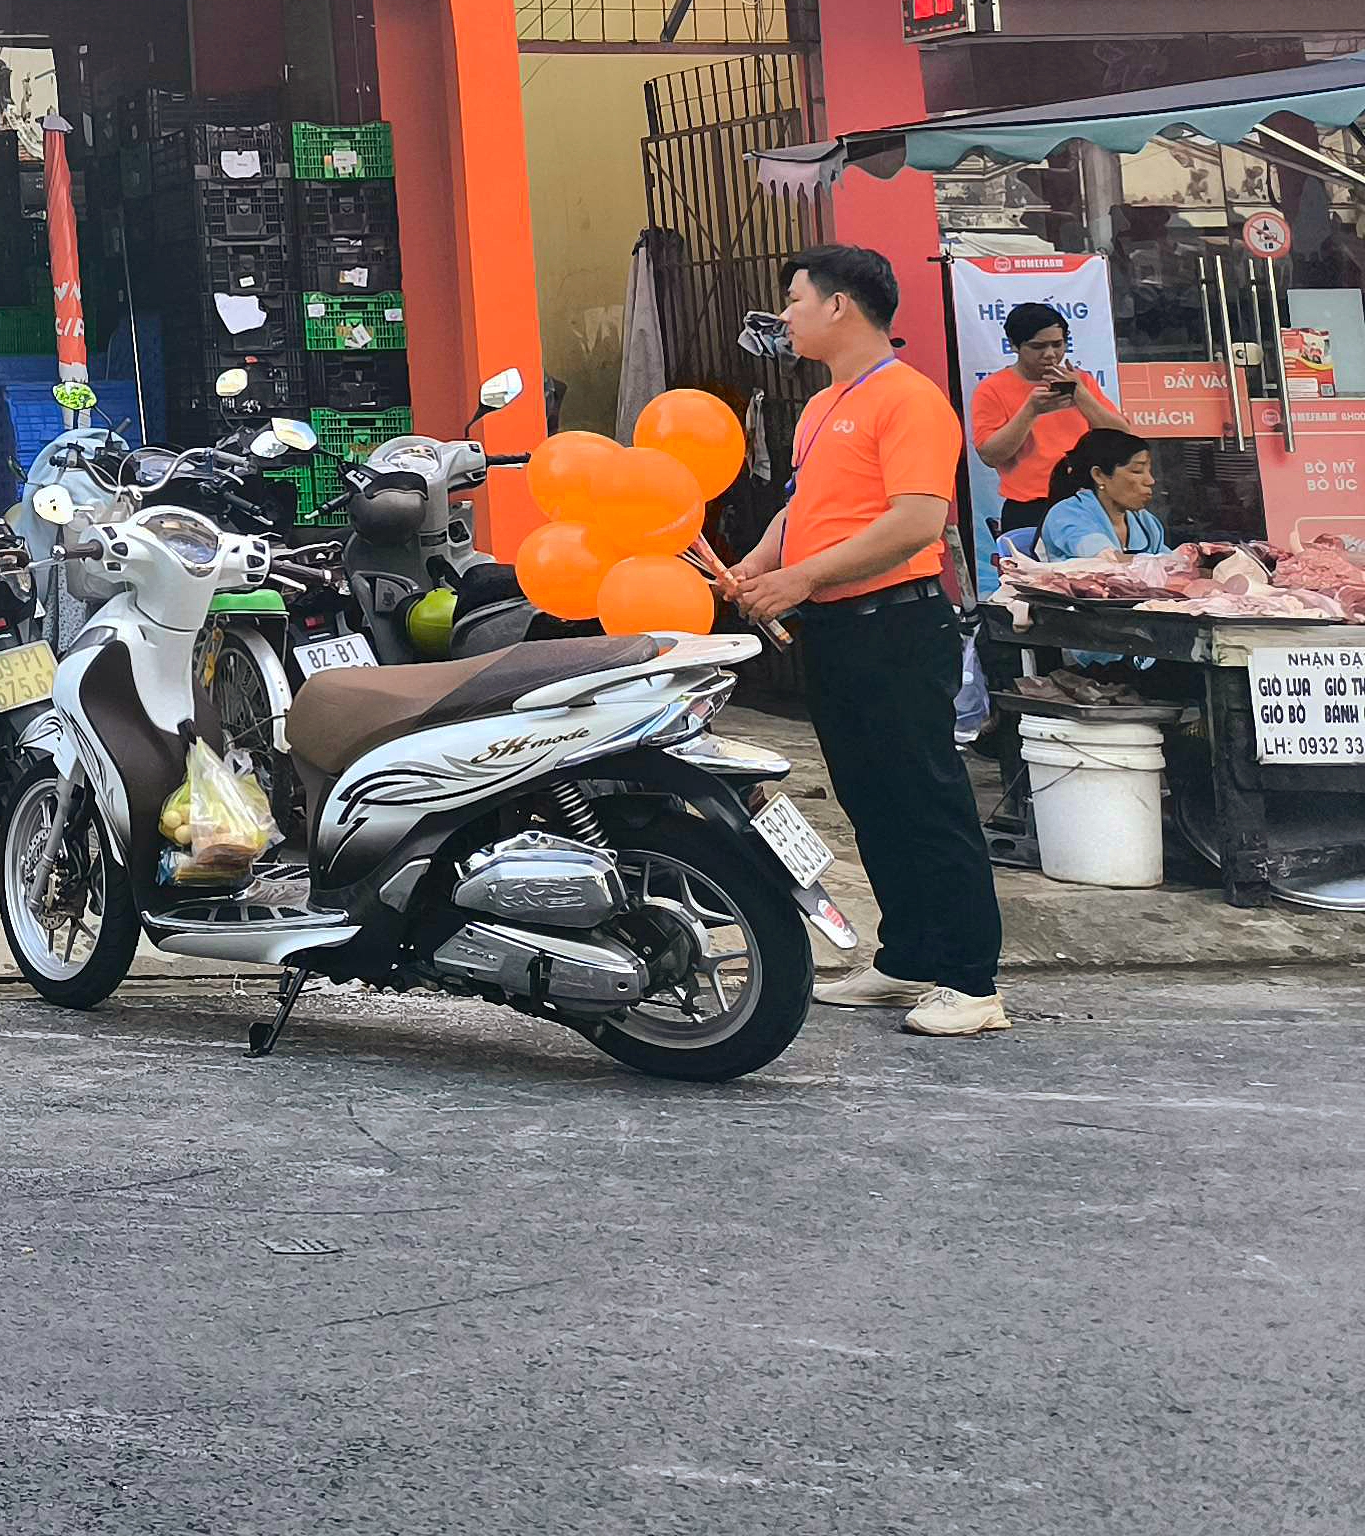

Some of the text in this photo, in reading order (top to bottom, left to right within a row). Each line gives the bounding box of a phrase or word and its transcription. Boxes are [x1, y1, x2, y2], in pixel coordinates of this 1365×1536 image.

[979, 298, 1006, 325] HỆ
[1164, 368, 1195, 389] ĐẨY
[1133, 408, 1195, 425] KHÁCH
[1304, 459, 1356, 474] BÒ MỸ
[1306, 476, 1358, 491] BÒ ÚC
[307, 641, 359, 669] 82-B1
[1258, 673, 1282, 696] GIÒ
[1324, 673, 1347, 696] GIÒ
[1260, 697, 1359, 724] GIÒ BÒ BÁNH
[1299, 737, 1338, 754] 0932
